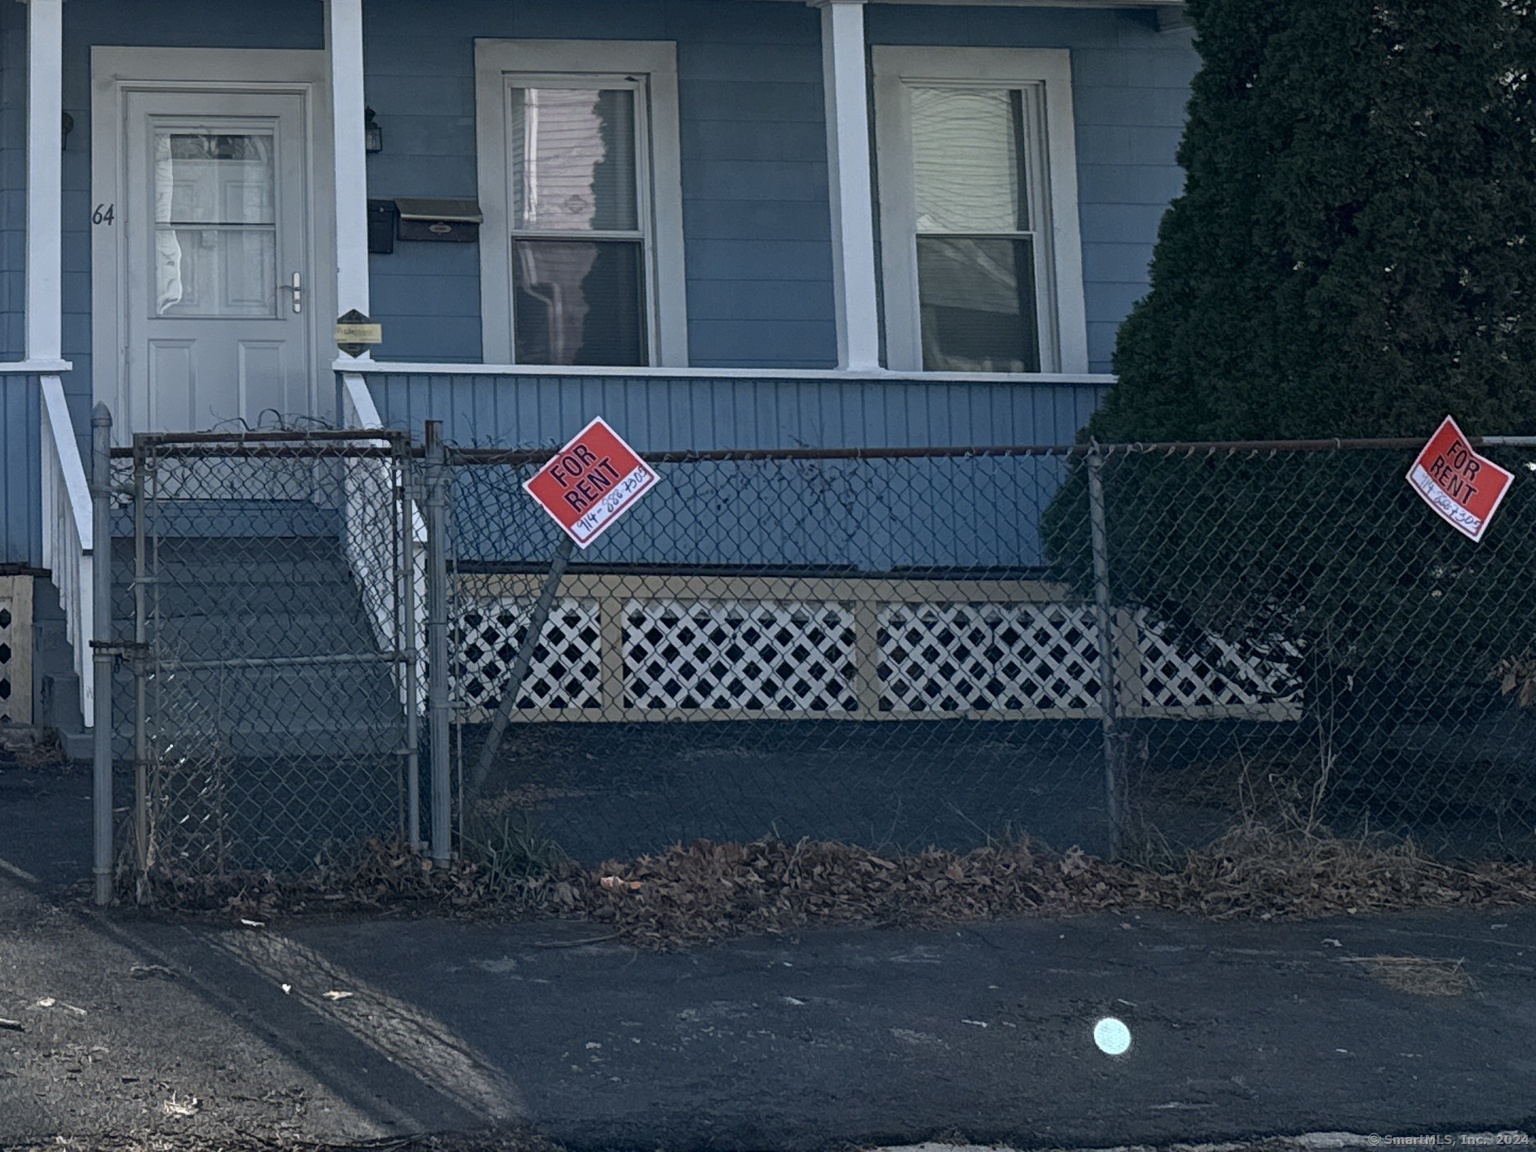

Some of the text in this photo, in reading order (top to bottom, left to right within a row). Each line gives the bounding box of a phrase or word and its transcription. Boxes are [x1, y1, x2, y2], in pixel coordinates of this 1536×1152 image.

[92, 203, 115, 226] 64
[549, 444, 597, 488] FOR
[1430, 454, 1477, 504] RENT
[1446, 439, 1480, 482] FOR
[564, 457, 620, 513] RENT
